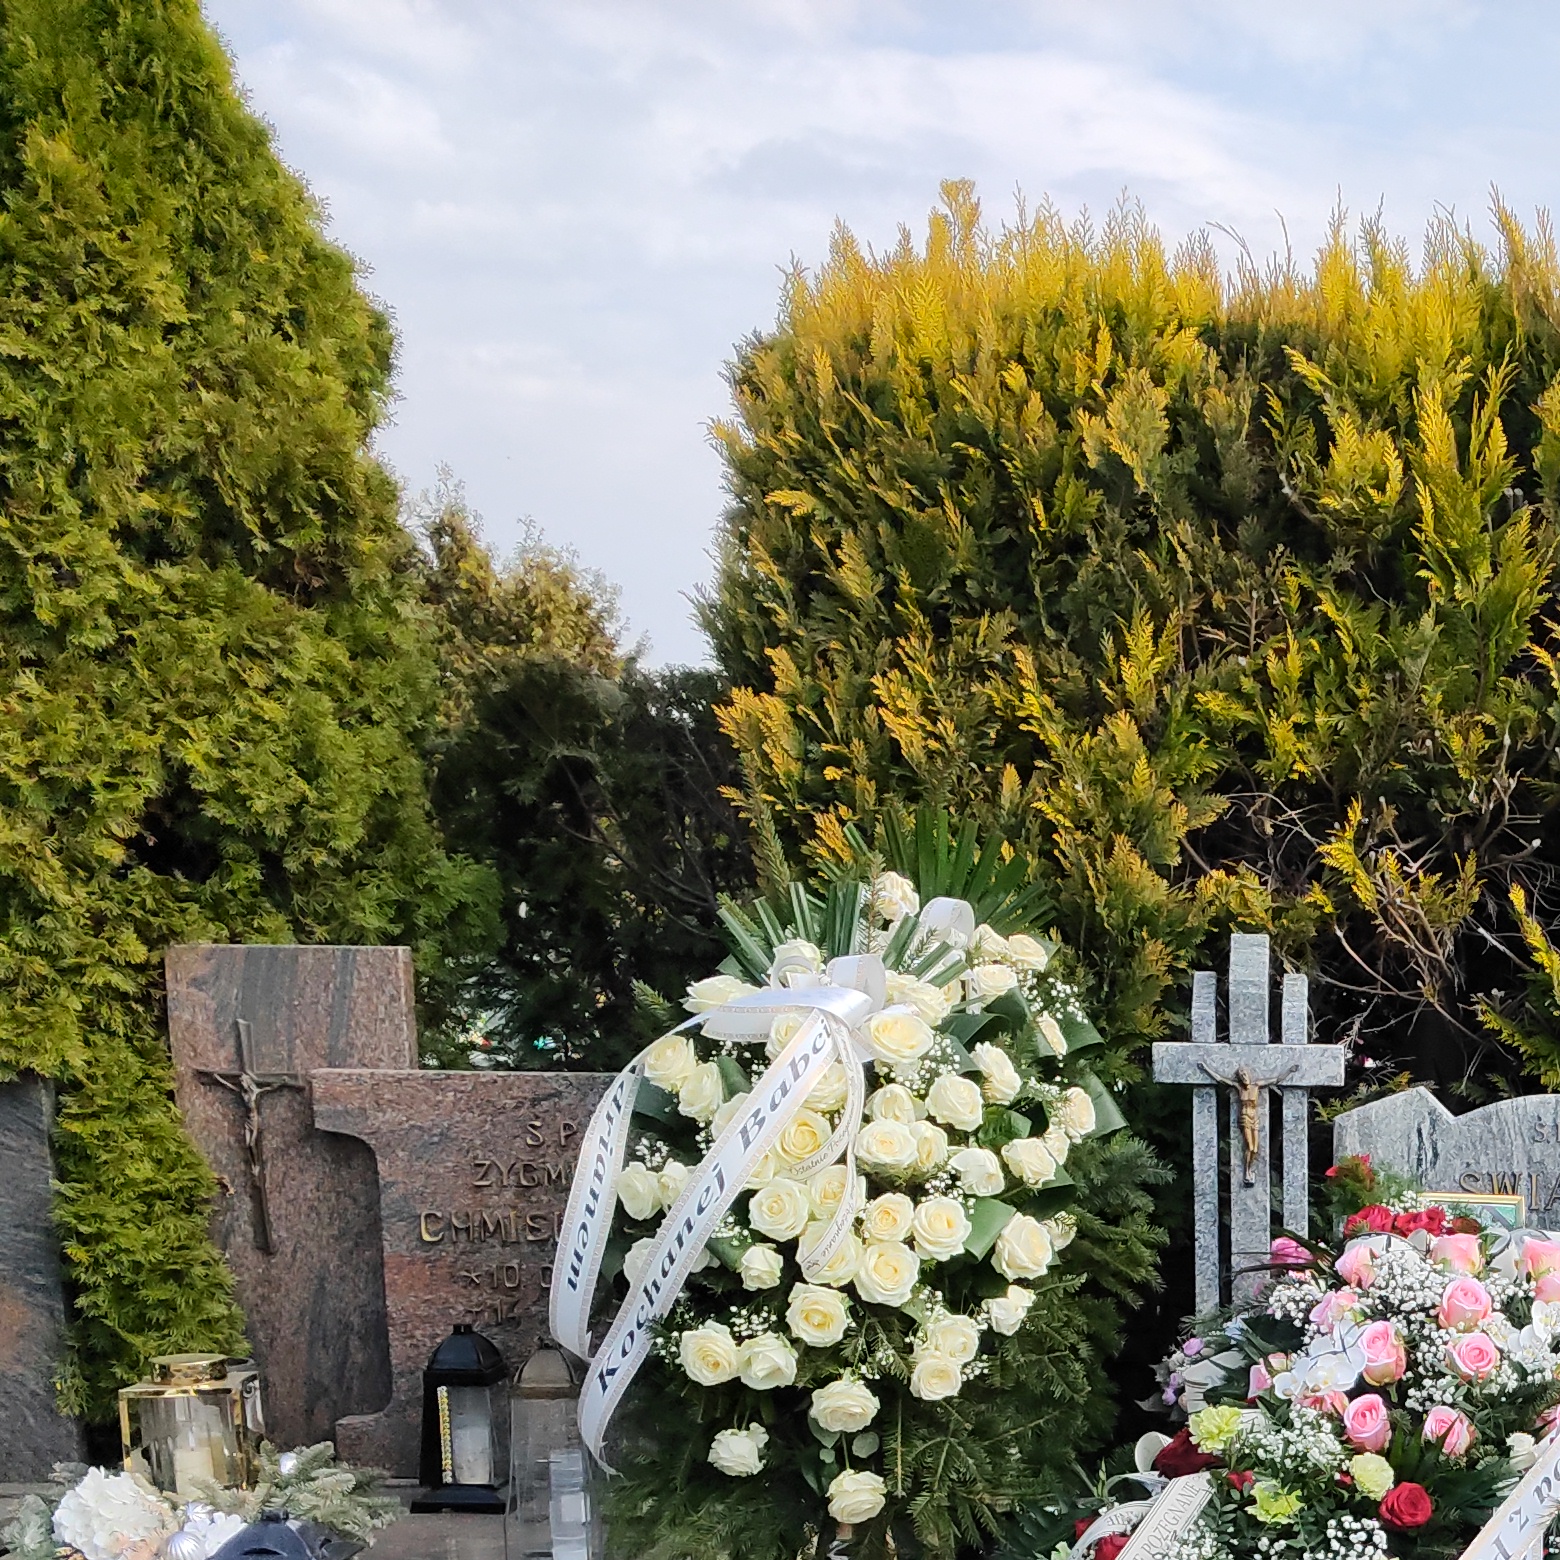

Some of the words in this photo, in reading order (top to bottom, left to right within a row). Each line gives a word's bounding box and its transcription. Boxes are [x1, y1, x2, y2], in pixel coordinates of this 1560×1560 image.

[472, 1159, 577, 1187] ZYGM
[566, 1067, 636, 1293] drianem
[596, 1161, 727, 1396] Kochanej
[737, 1018, 833, 1157] Babci
[1508, 1506, 1529, 1533] z
